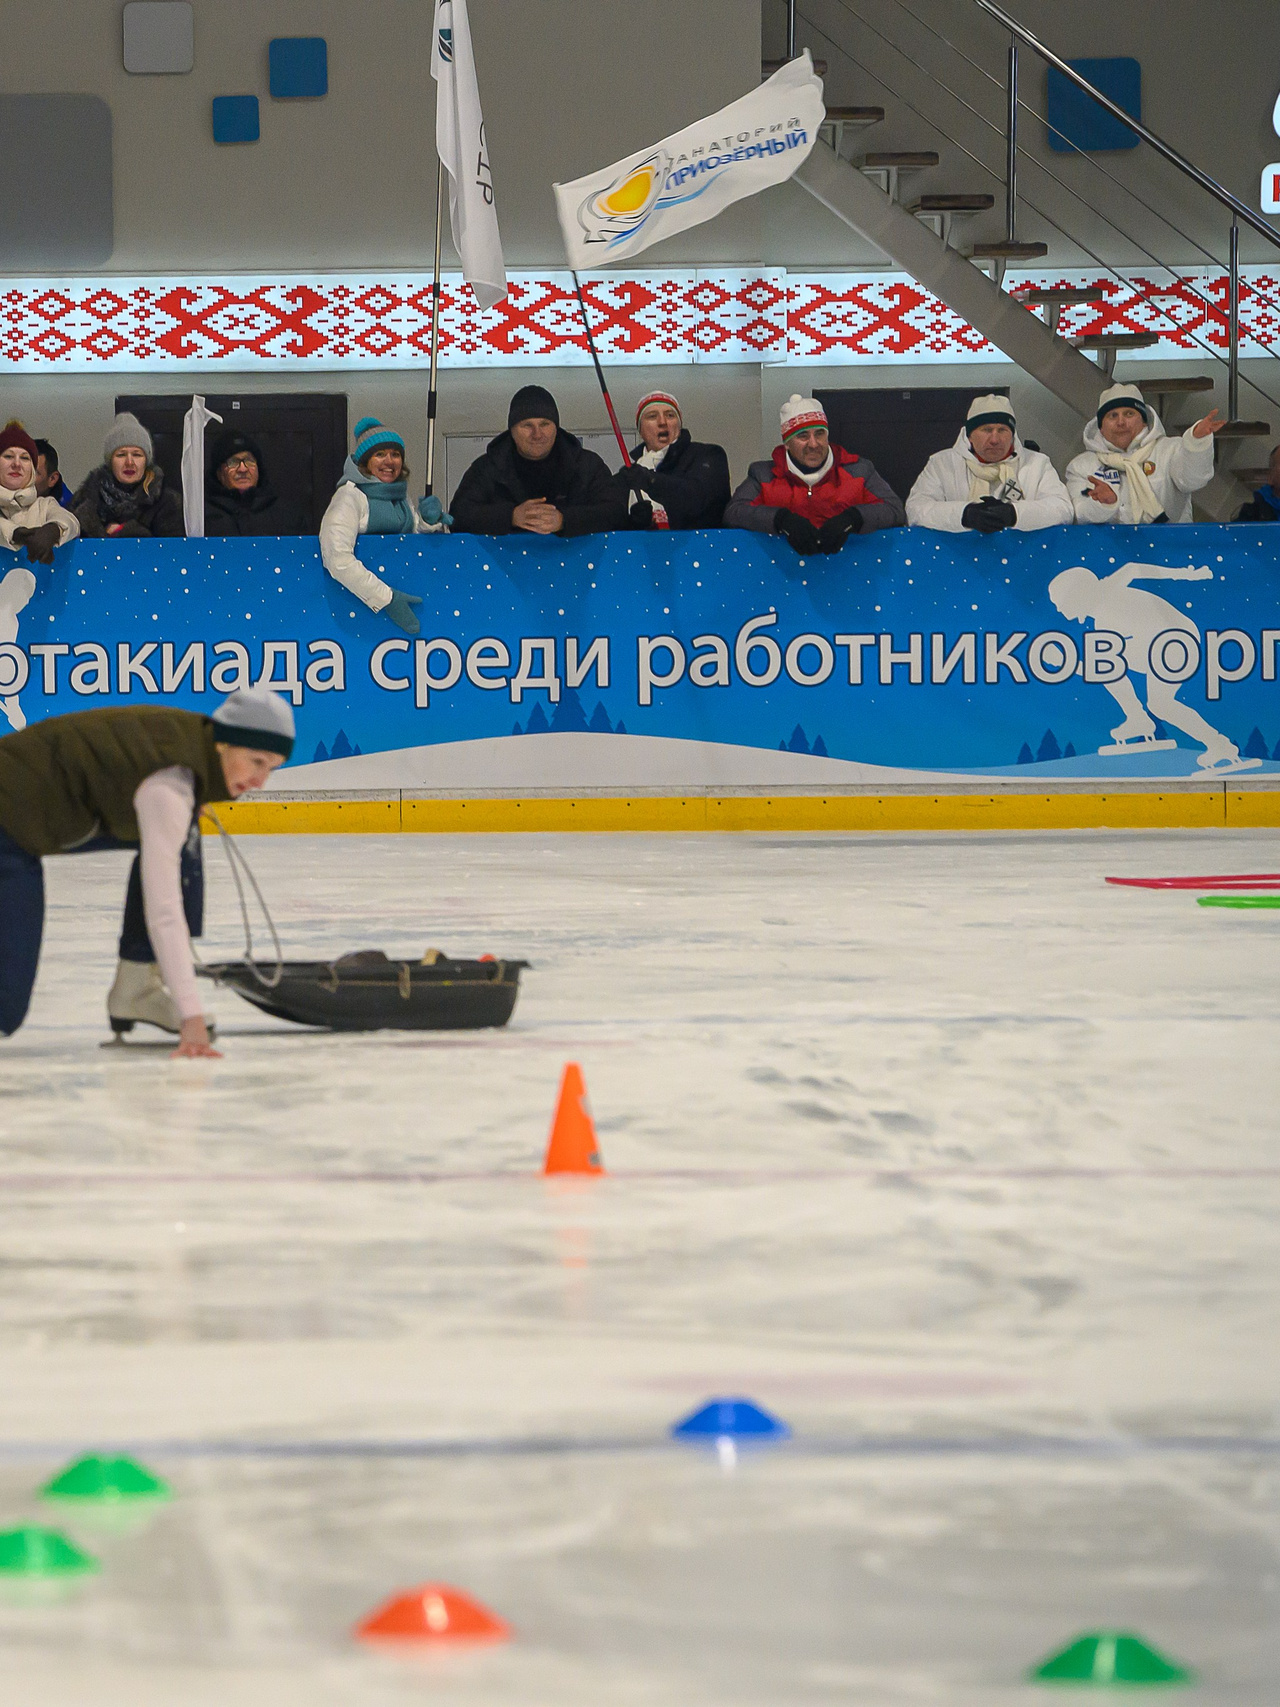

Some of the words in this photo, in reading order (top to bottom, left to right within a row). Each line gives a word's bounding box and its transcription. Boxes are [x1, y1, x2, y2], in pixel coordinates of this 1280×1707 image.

[665, 128, 807, 190] ПРИОЗЁРНЫЙ
[668, 117, 801, 166] АНАТОРИЙ
[370, 636, 609, 707] среди
[638, 613, 1127, 705] работников
